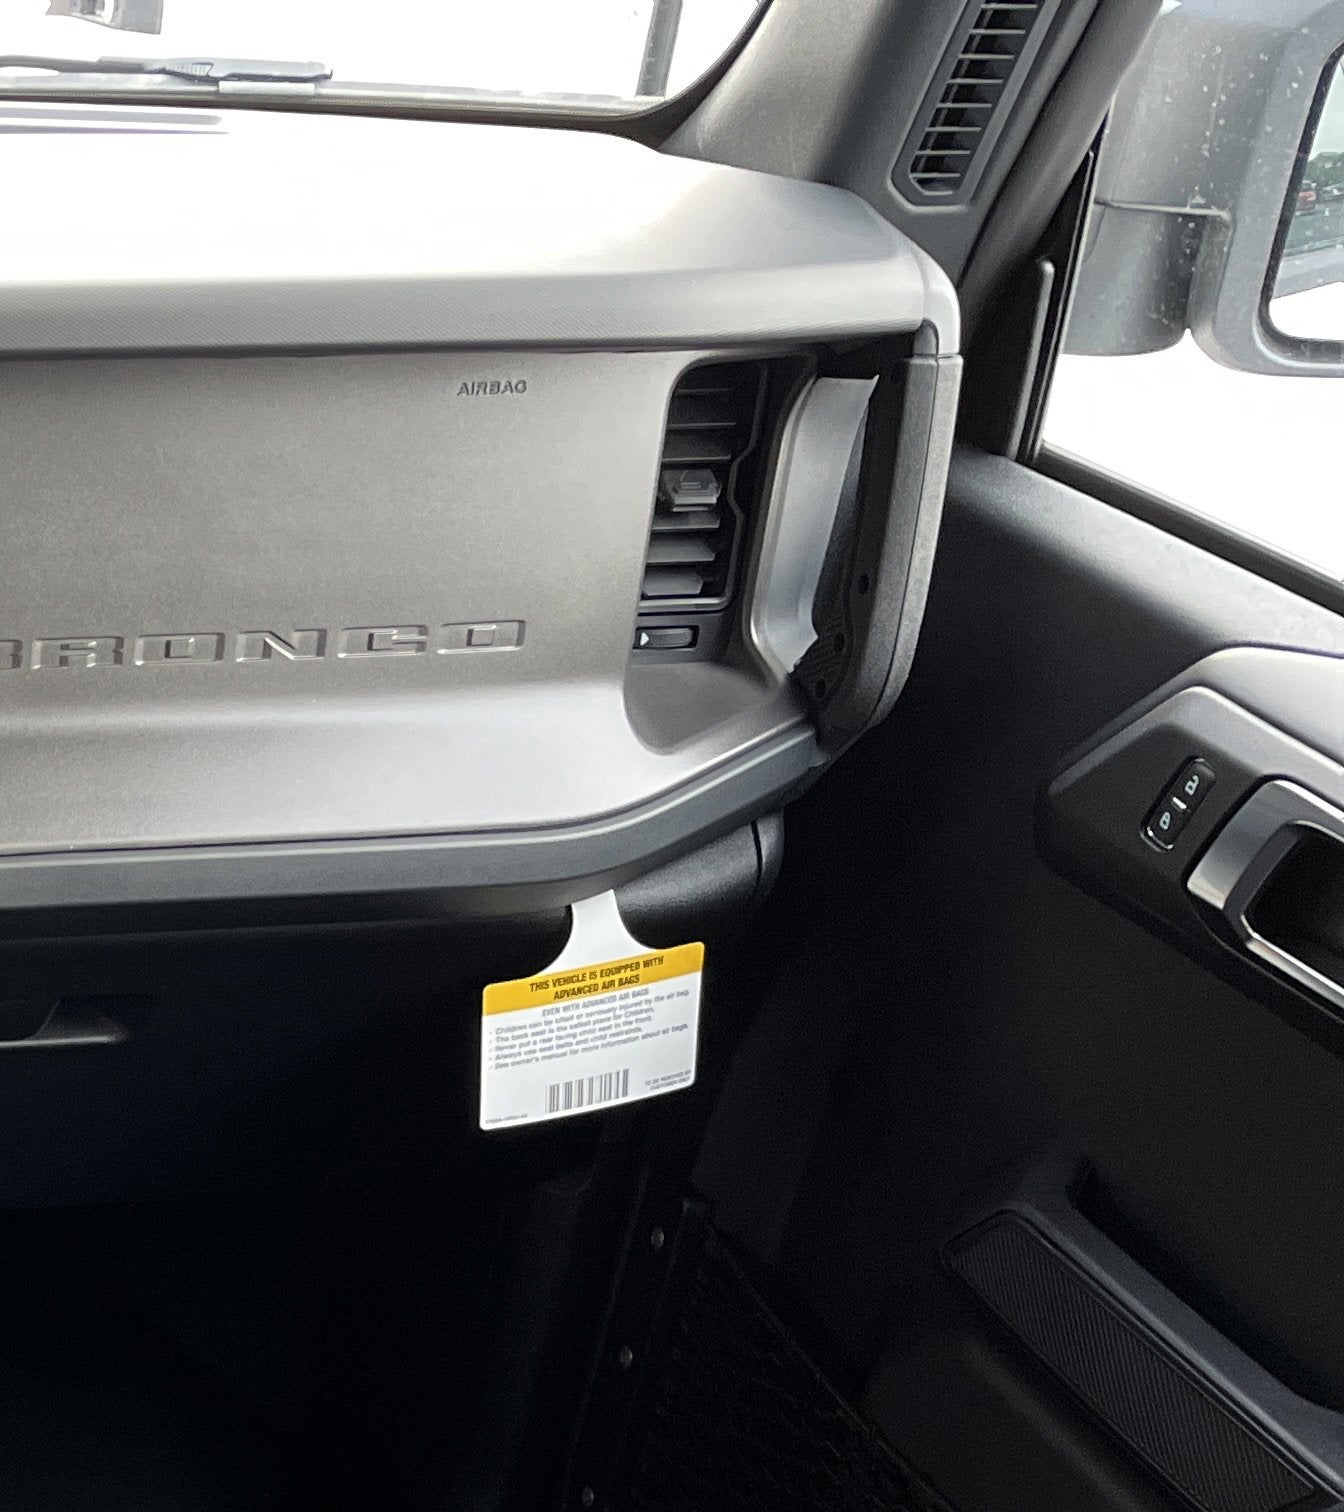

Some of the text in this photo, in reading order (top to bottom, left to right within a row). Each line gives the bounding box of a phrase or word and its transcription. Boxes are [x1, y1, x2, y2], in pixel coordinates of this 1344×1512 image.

[455, 378, 529, 398] AIRBAG
[530, 955, 664, 992] THIS VEHICLE IS EQUIPPED WITH
[553, 974, 640, 1000] ADVANCED AIR BAGS
